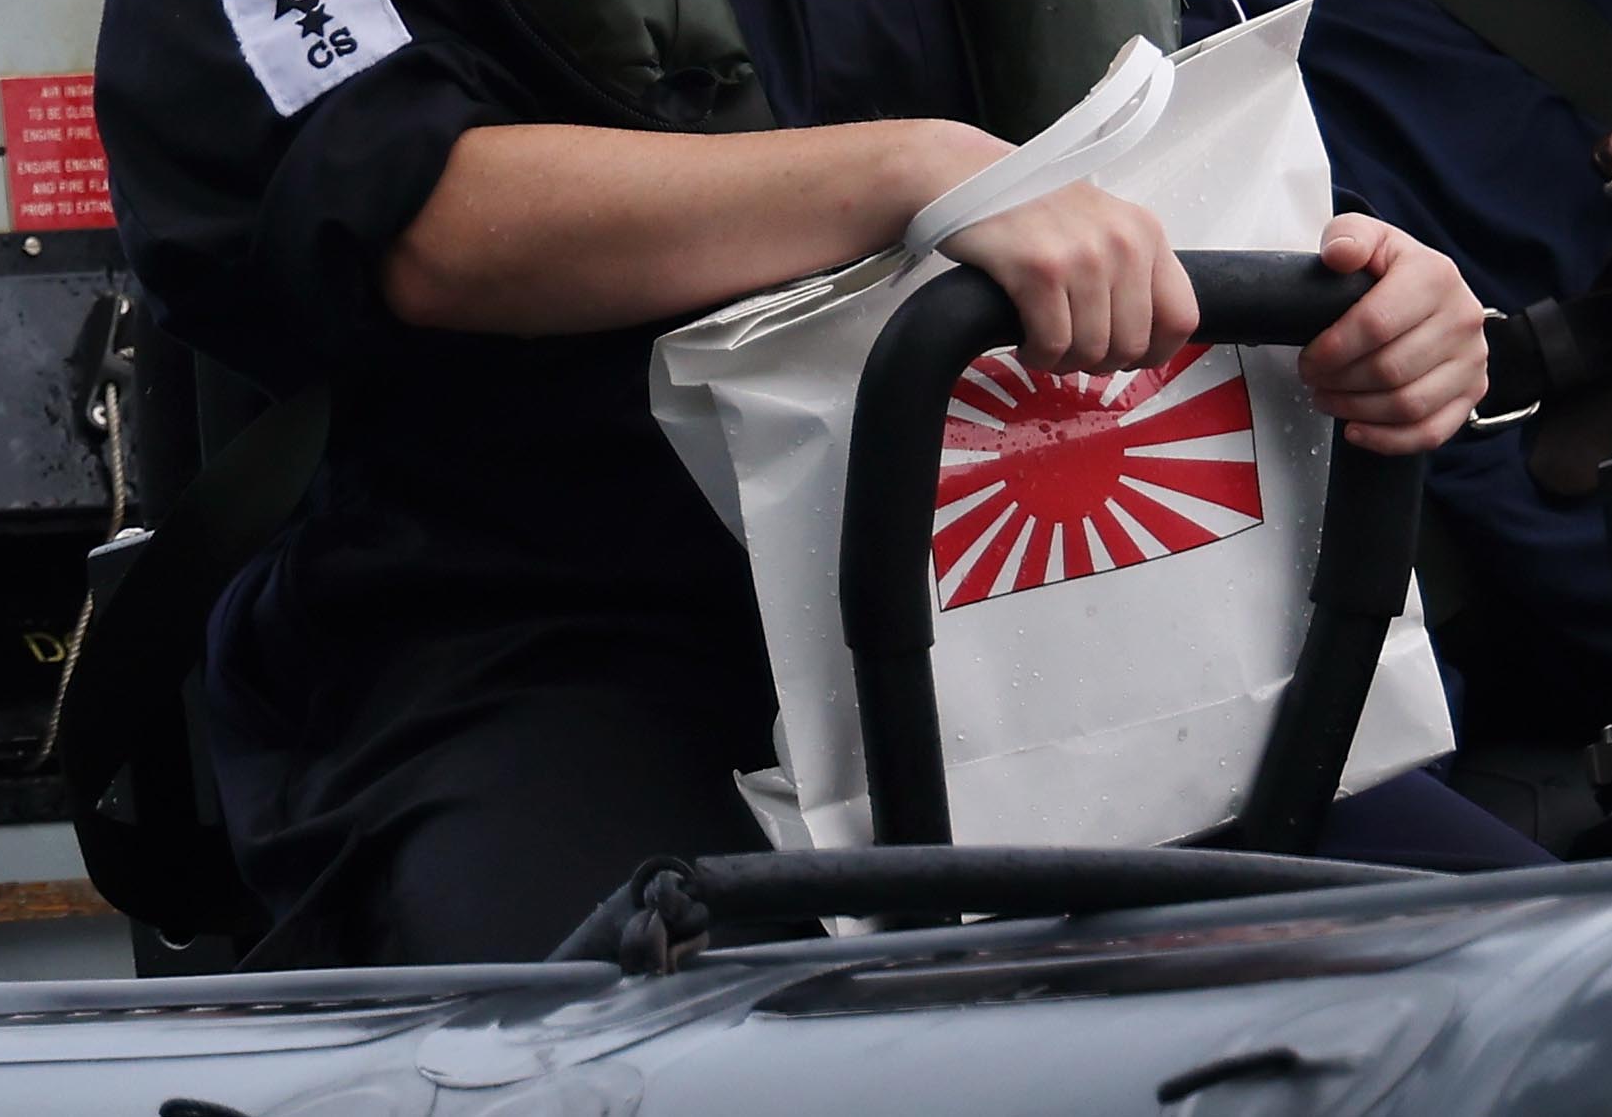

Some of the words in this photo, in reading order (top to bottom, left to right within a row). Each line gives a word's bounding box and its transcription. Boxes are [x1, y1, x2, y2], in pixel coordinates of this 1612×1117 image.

[306, 26, 359, 70] CS
[28, 108, 44, 120] TO
[47, 107, 61, 120] BE
[23, 129, 61, 142] ENGINE
[67, 127, 92, 139] FIRE
[18, 160, 60, 174] ENSURE
[65, 158, 104, 172] ENGINE
[33, 182, 56, 194] AND
[60, 180, 83, 193] FIRE
[21, 203, 54, 216] PRIOR
[58, 202, 71, 215] TO
